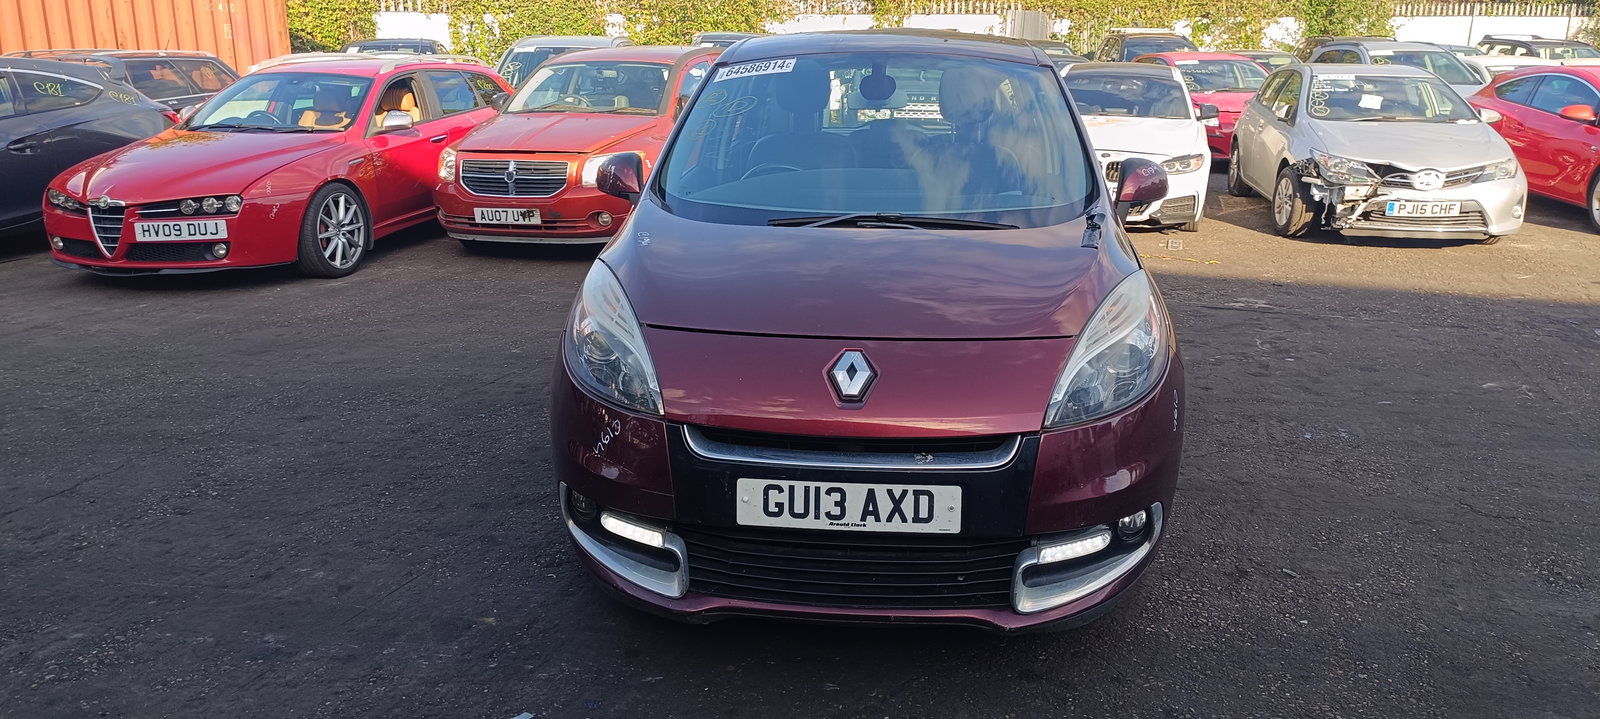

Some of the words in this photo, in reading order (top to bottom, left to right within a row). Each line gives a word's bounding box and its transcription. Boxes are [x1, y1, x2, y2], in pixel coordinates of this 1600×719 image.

[33, 81, 65, 96] C181
[481, 210, 509, 221] AU07
[1398, 203, 1428, 214] PJ15
[1431, 203, 1457, 214] CHF
[141, 224, 182, 237] HV09
[187, 222, 219, 236] DUJ
[762, 483, 847, 521] GU13
[859, 487, 935, 524] AXD
